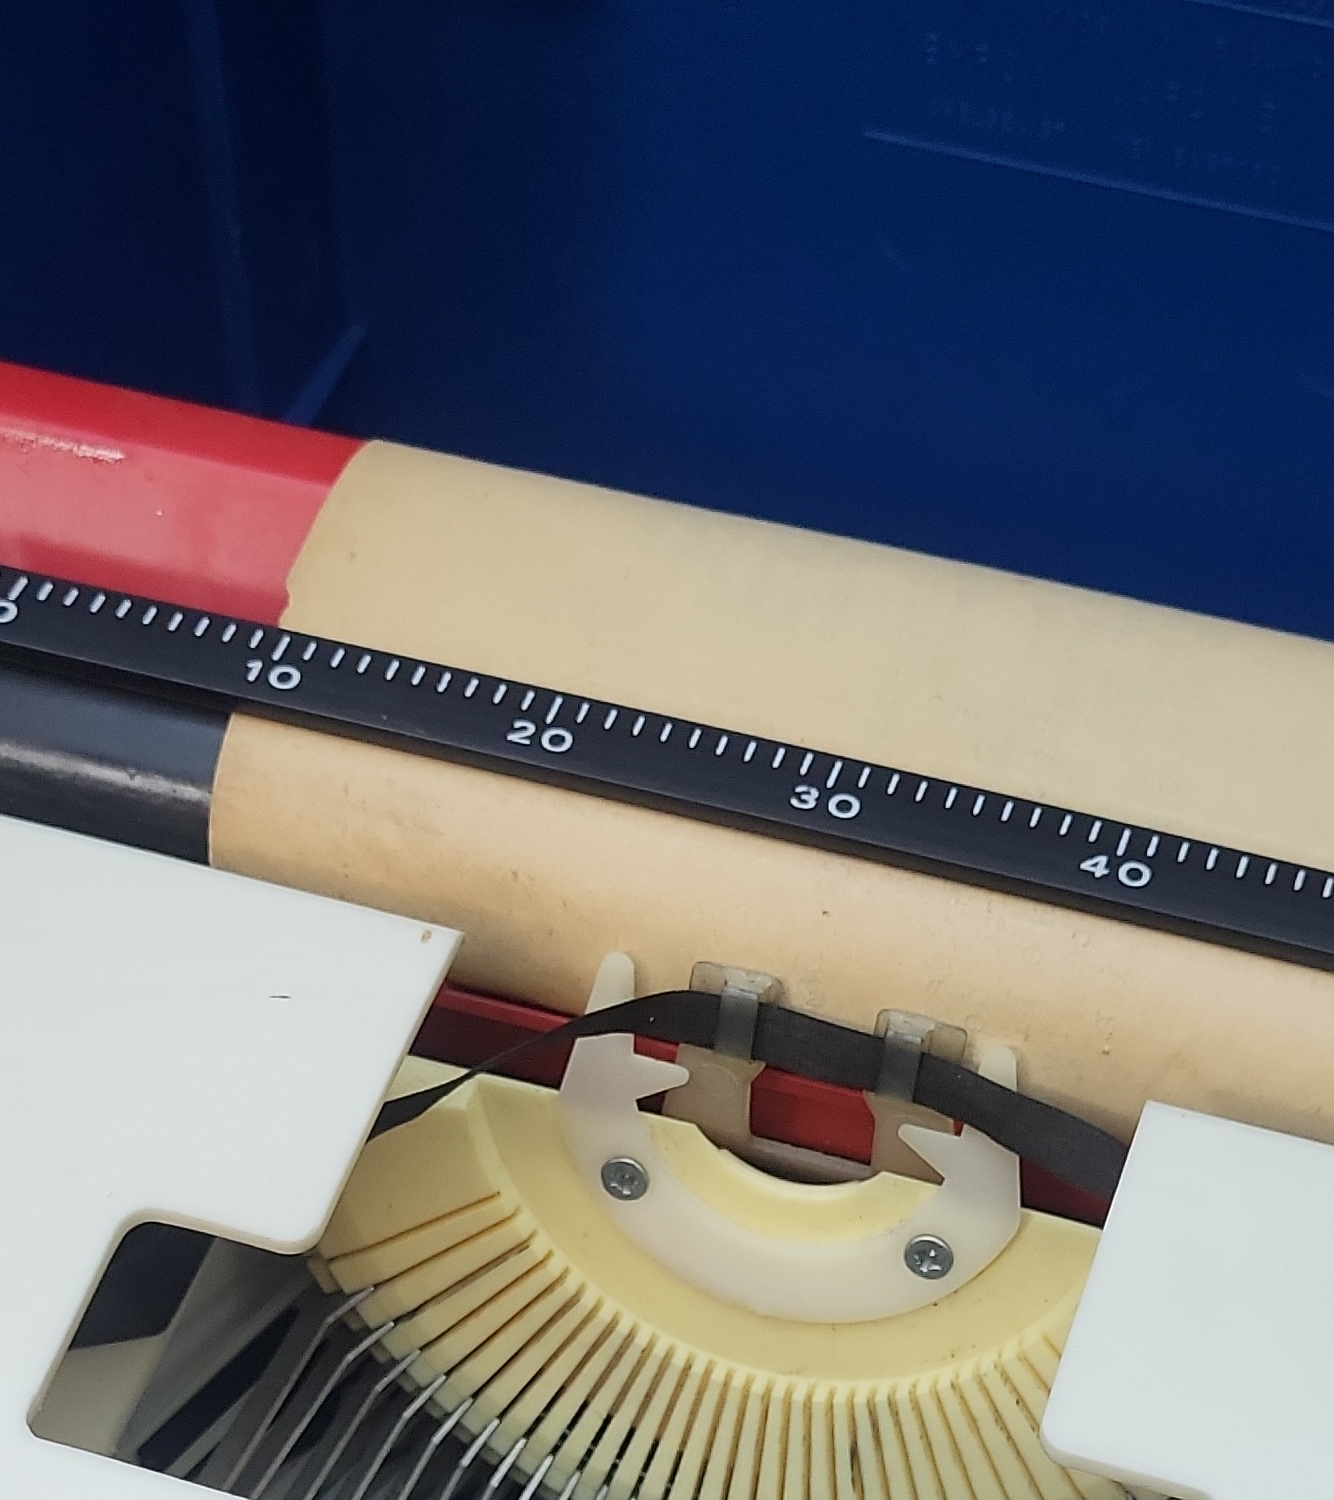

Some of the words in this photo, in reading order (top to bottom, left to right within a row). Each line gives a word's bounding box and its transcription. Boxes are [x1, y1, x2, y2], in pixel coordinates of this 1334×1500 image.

[244, 657, 302, 691] 10
[506, 719, 574, 754] 20
[788, 784, 863, 820] 30
[1077, 853, 1154, 889] 40
